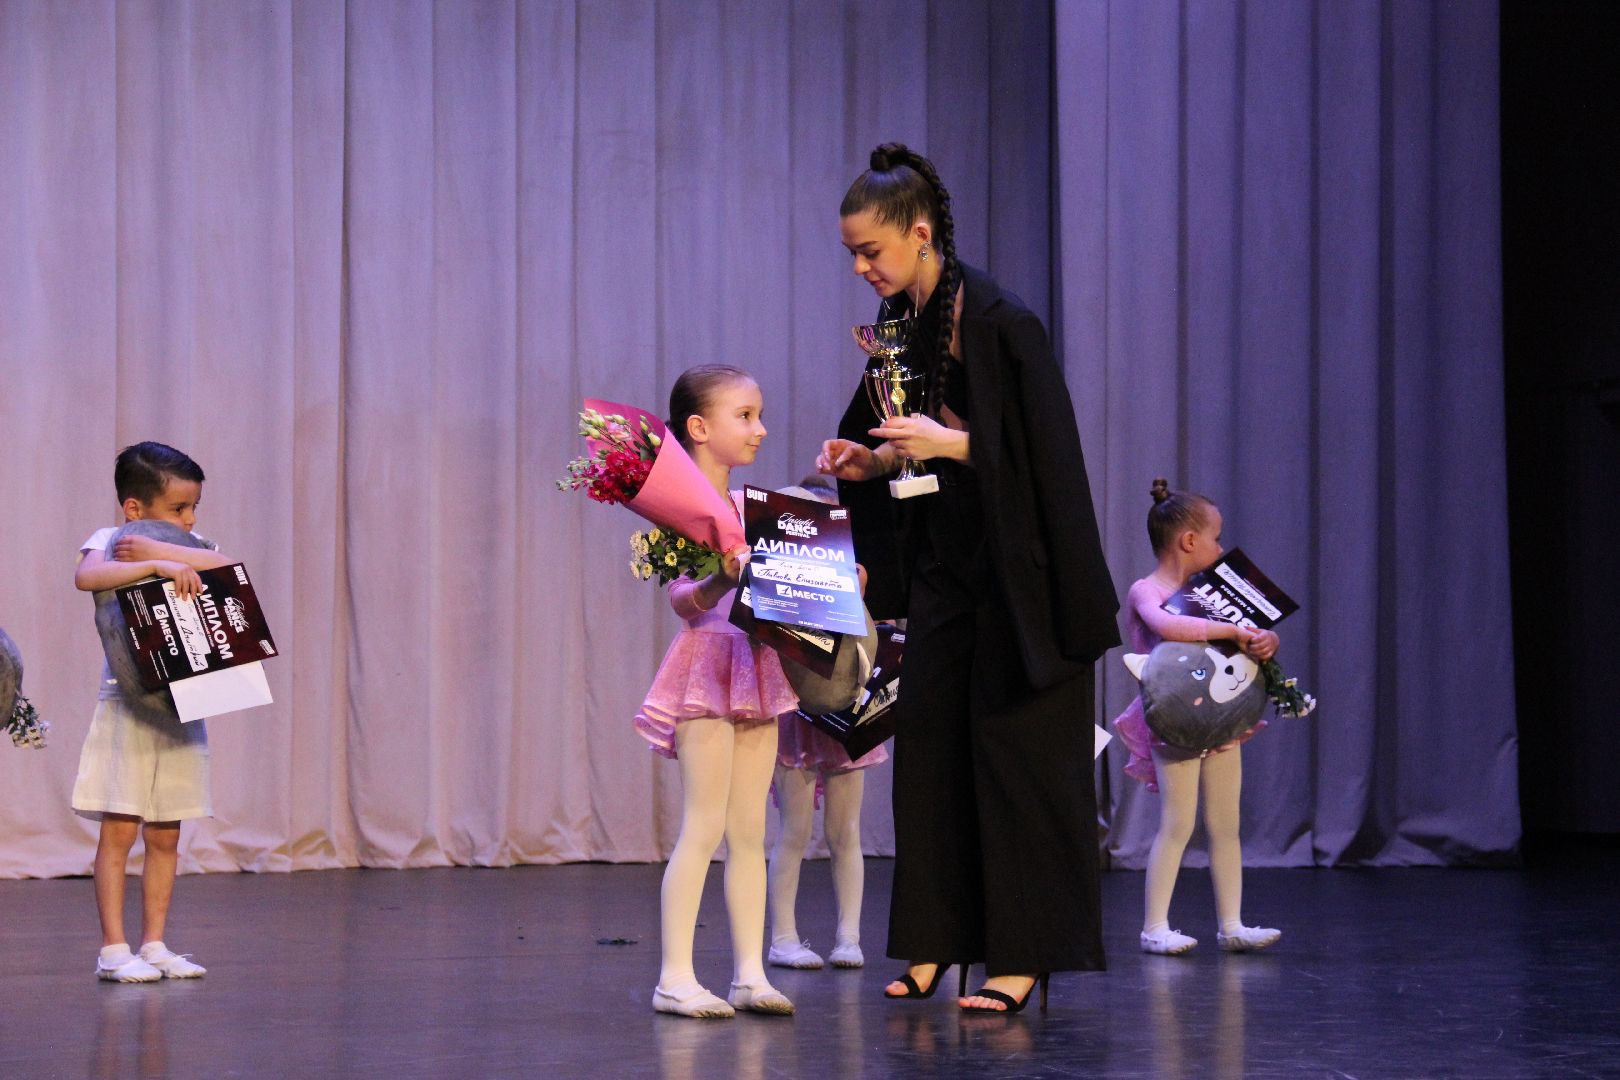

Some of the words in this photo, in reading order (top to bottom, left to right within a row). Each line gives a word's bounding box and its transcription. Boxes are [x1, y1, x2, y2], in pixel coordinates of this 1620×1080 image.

[746, 488, 768, 503] BUNT
[777, 519, 818, 536] DANCE
[754, 537, 845, 563] ДИПЛОМ
[792, 589, 835, 603] МЕСТО
[1233, 596, 1247, 608] MAY
[224, 597, 245, 634] DANCE
[158, 619, 179, 656] МЕСТО
